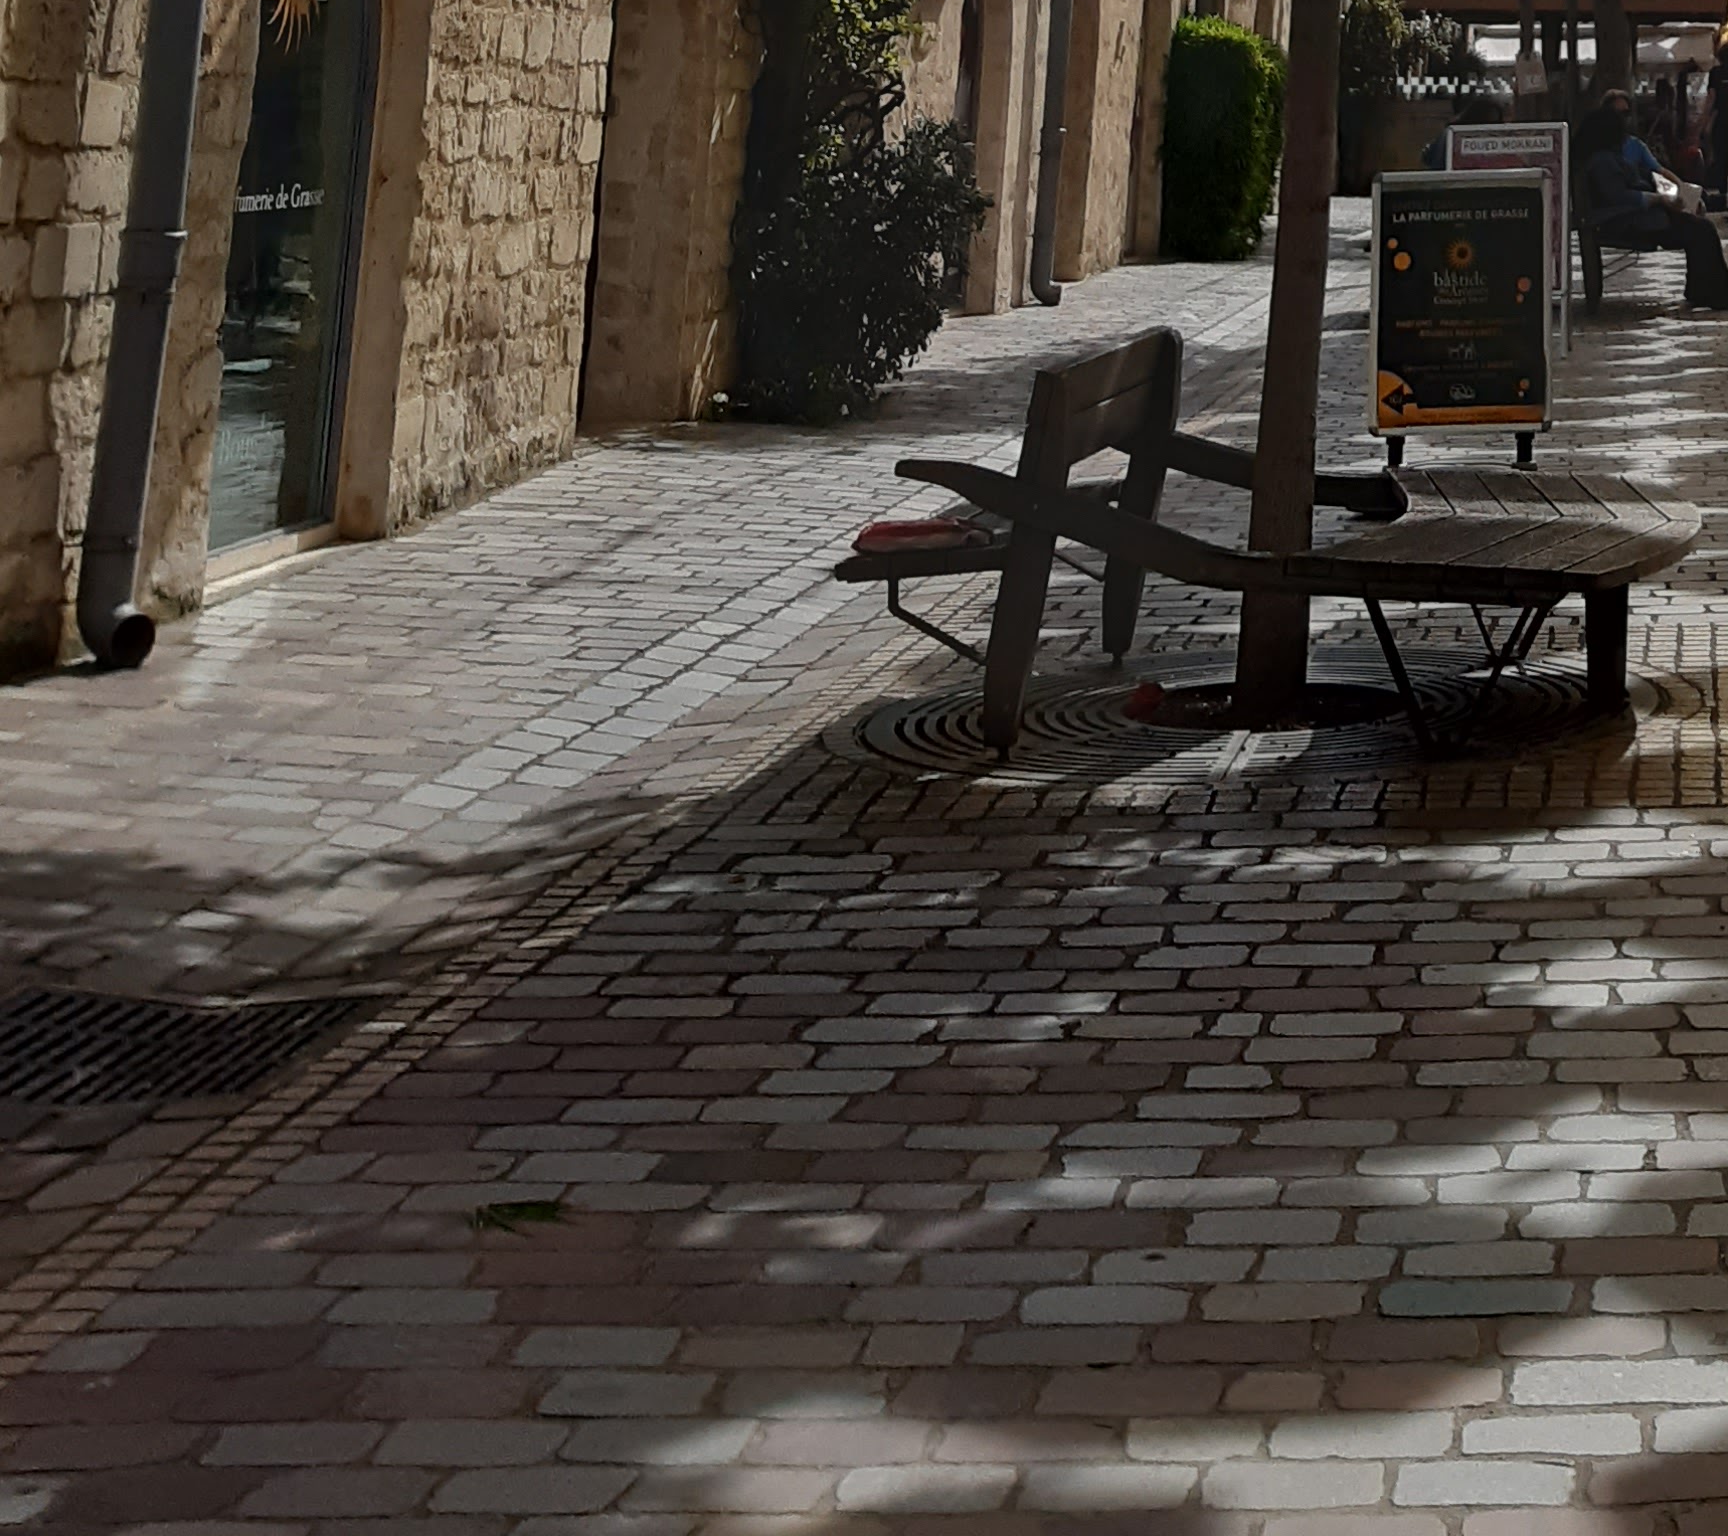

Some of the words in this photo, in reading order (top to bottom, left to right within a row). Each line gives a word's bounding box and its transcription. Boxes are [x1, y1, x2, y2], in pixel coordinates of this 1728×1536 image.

[234, 185, 275, 213] fumerie
[275, 183, 289, 209] de
[1392, 212, 1406, 223] LA
[1409, 210, 1473, 222] PARFUMERIE
[1475, 209, 1488, 220] DE
[1490, 208, 1529, 218] GRASSE
